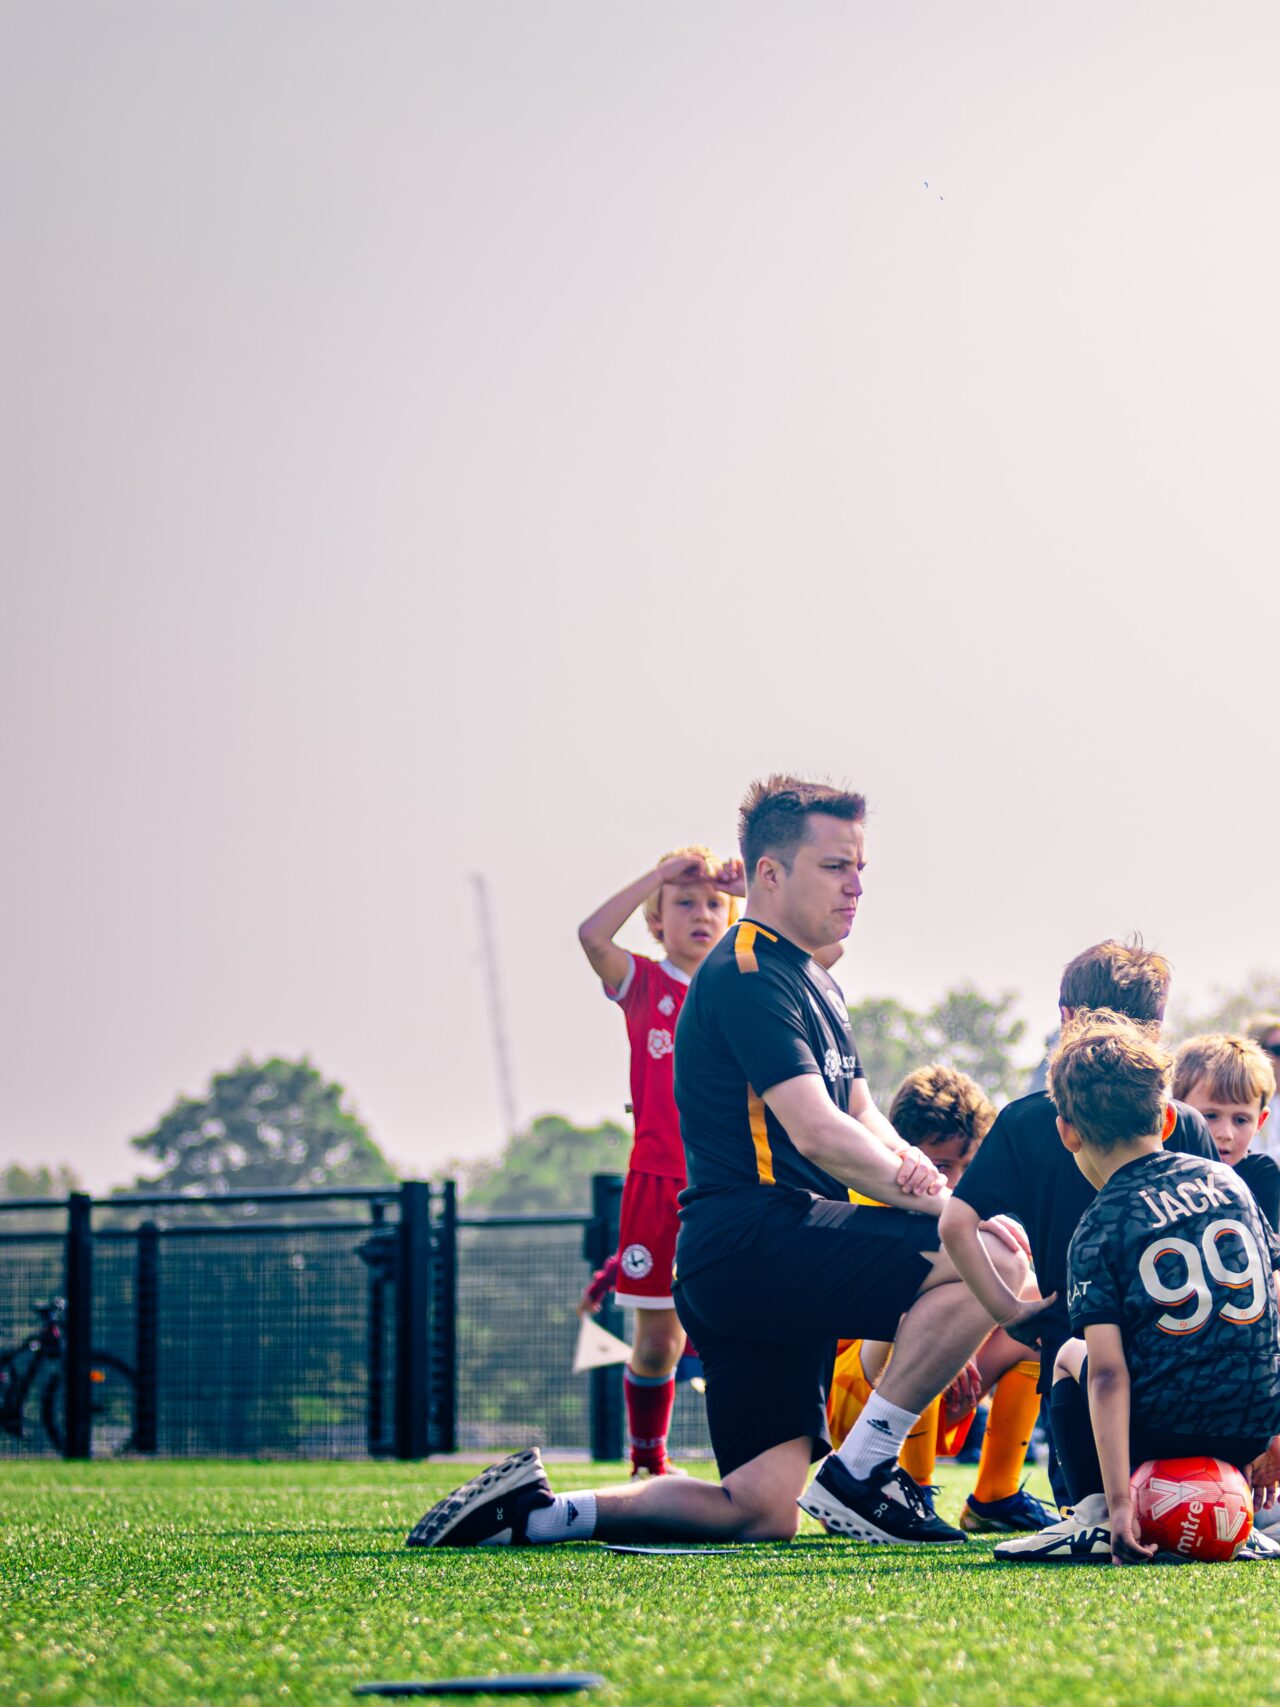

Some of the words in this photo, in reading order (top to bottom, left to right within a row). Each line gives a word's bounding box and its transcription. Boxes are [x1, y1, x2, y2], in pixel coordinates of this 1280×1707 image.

[1138, 1173, 1232, 1228] JACK
[1138, 1218, 1267, 1336] 99
[1176, 1500, 1204, 1554] mitre
